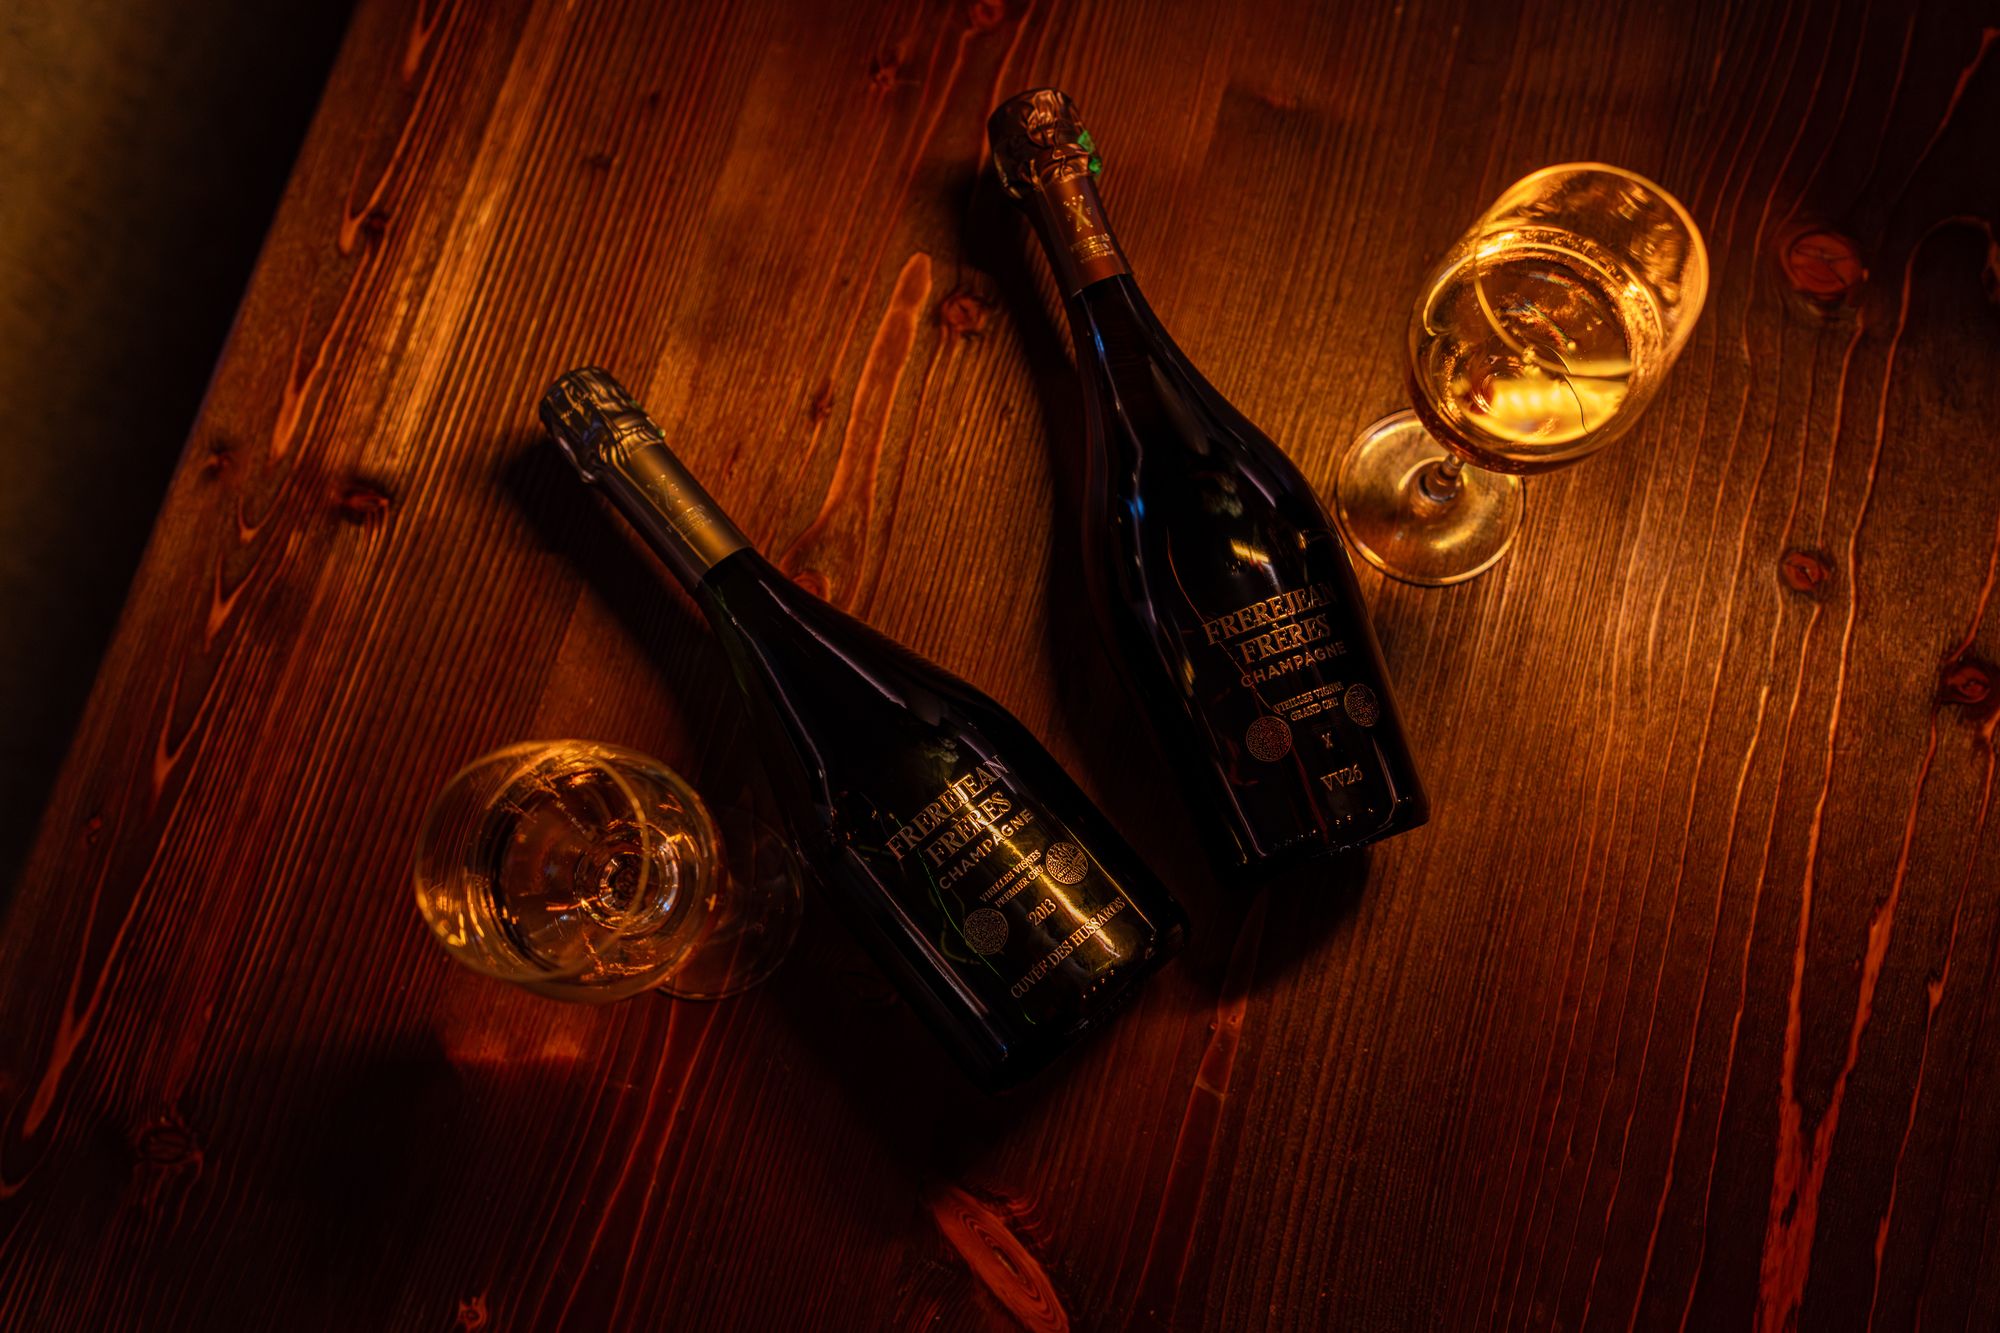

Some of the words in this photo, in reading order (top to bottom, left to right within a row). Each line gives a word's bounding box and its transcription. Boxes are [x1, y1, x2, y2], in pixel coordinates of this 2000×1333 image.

[1201, 581, 1338, 646] FREREJEAN
[1235, 613, 1331, 665] FRÈRES
[1241, 640, 1348, 687] CHAMPAGNE
[1290, 702, 1322, 722] GRAND
[1322, 696, 1340, 712] CRU
[1320, 762, 1364, 792] VV26
[885, 754, 1009, 861] FREREJEAN
[925, 790, 1012, 868] FRÈRES
[939, 808, 1034, 890] CHAMPAGNE
[1012, 849, 1042, 877] VIGNES
[994, 875, 1031, 908] PREMIER
[1028, 864, 1045, 882] CRU
[1027, 898, 1057, 927] 2013
[1048, 942, 1074, 969] DES
[1069, 896, 1126, 949] HUSSARDS
